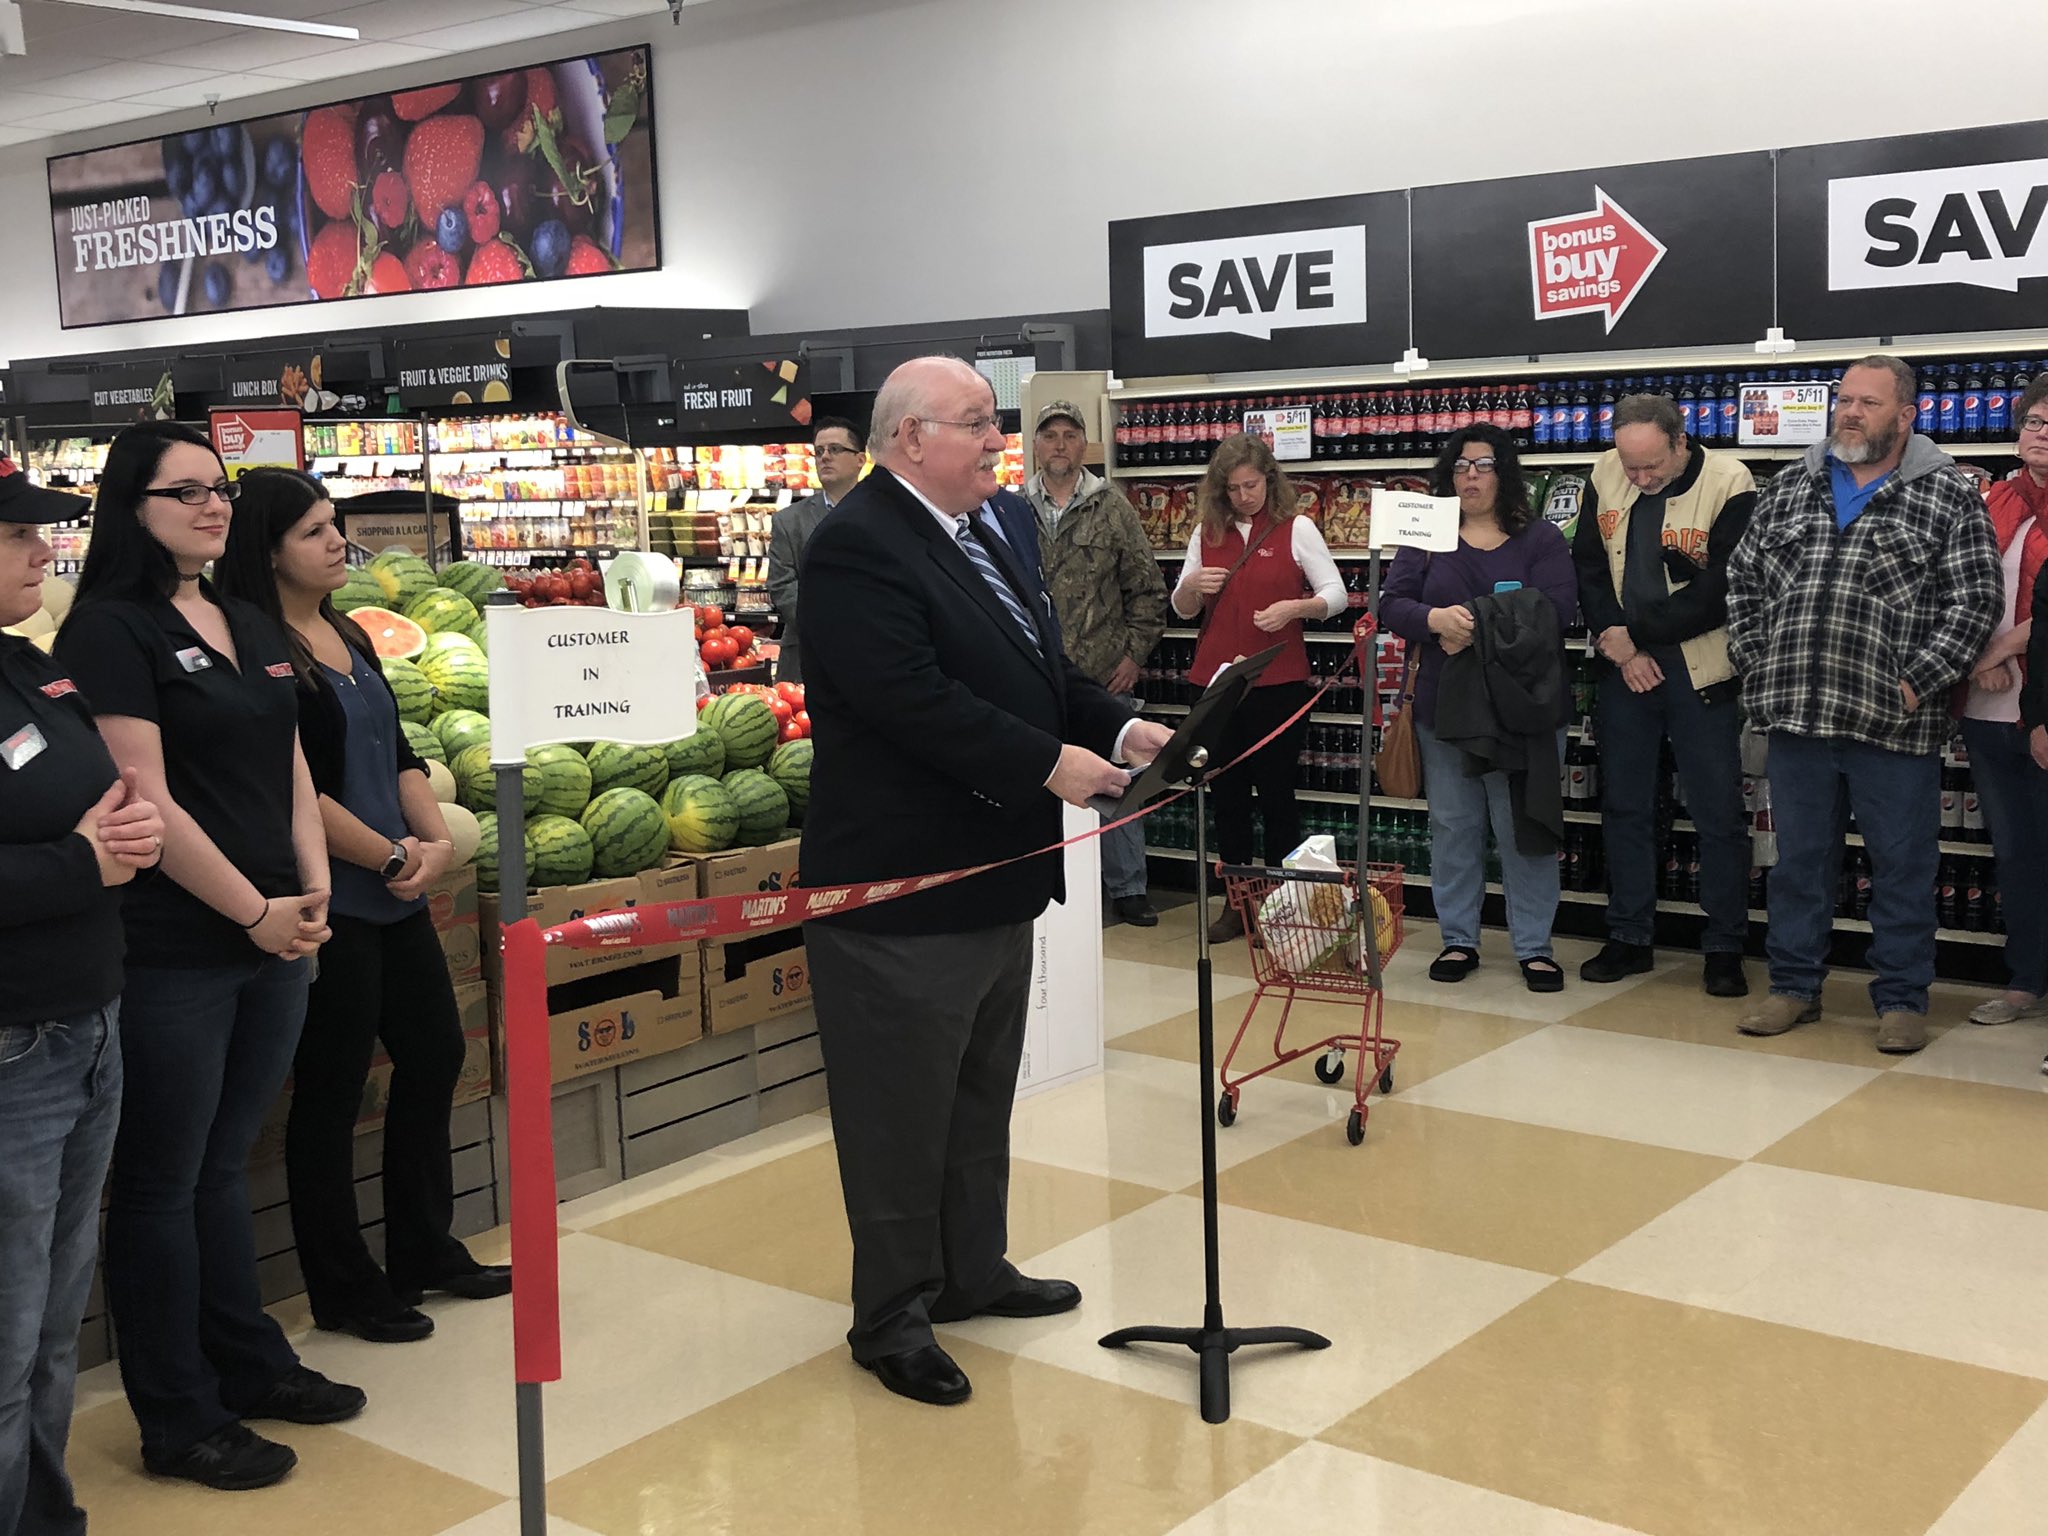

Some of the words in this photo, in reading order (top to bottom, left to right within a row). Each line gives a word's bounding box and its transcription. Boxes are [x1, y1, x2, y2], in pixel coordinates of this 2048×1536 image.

[71, 196, 150, 232] JUST-PICKED
[73, 206, 277, 272] FRESHNESS
[1542, 225, 1616, 251] bonus
[1544, 246, 1620, 284] buy
[1168, 250, 1334, 319] SAVE
[1547, 280, 1621, 303] savings
[400, 369, 427, 387] FRUIT
[428, 368, 436, 385] &
[438, 366, 471, 384] VEGGIE
[473, 363, 508, 382] DRINKS
[94, 391, 109, 406] CUT
[109, 388, 154, 405] VEGETABLES
[232, 381, 259, 397] LUNCH
[262, 380, 278, 395] BOX
[1797, 387, 1823, 403] 5/$11
[684, 390, 717, 410] FRESH
[721, 388, 753, 408] FRUIT
[1286, 409, 1307, 424] 5/$11
[222, 433, 244, 446] buy
[1398, 502, 1433, 510] CUSTOMER
[1553, 497, 1572, 510] 11
[357, 526, 395, 537] SHOPPING
[396, 525, 401, 535] A
[402, 525, 412, 535] LA
[1398, 529, 1432, 538] TRAINING
[547, 630, 630, 648] CUSTOMER
[583, 668, 600, 680] IN
[554, 700, 631, 718] TRAINING
[741, 895, 788, 919] MARTIN'S
[805, 888, 852, 910] MARTIN'S
[570, 950, 643, 969] WATERMELONS
[1037, 936, 1047, 984] thousand
[1036, 989, 1047, 1010] four
